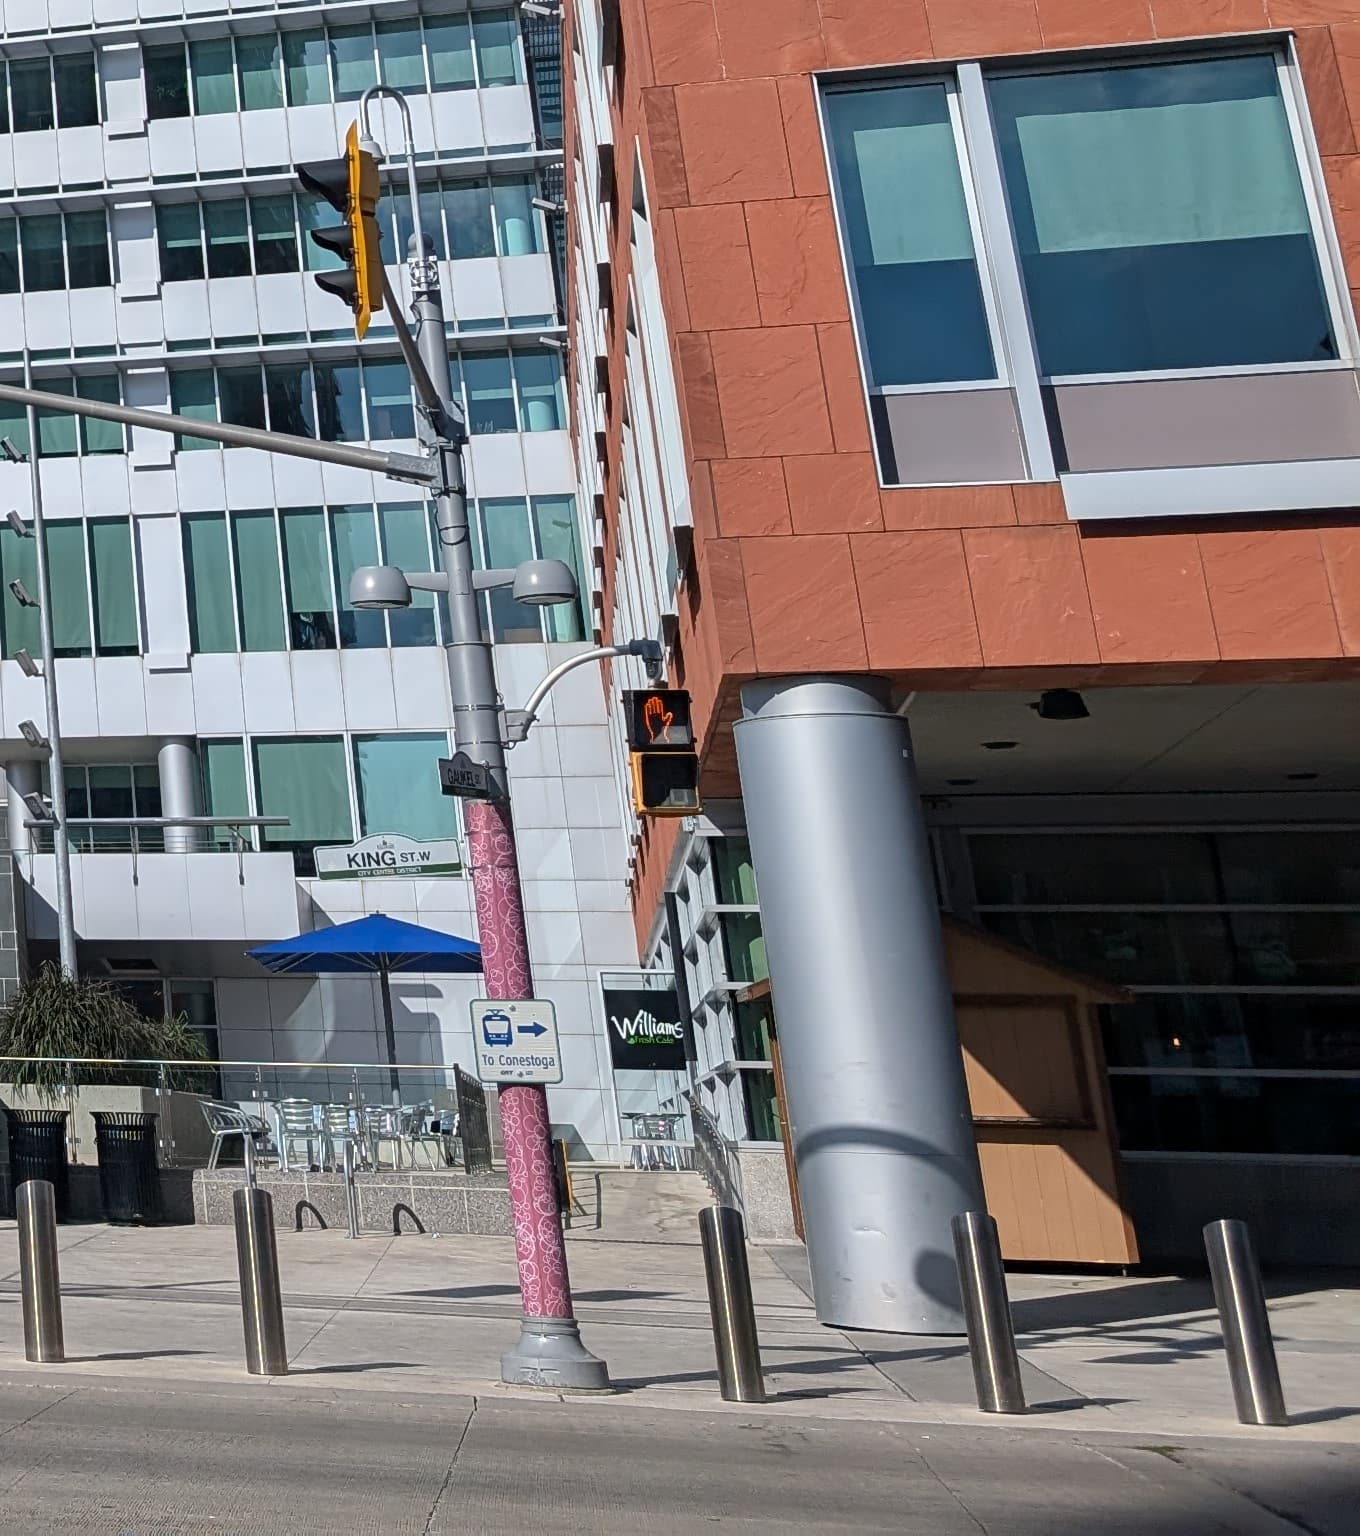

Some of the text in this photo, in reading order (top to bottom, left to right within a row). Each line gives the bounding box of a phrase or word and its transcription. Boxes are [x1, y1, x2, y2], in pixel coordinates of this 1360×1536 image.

[347, 851, 396, 868] KING
[610, 1009, 684, 1040] Williams
[482, 1054, 556, 1070] To Conestoga
